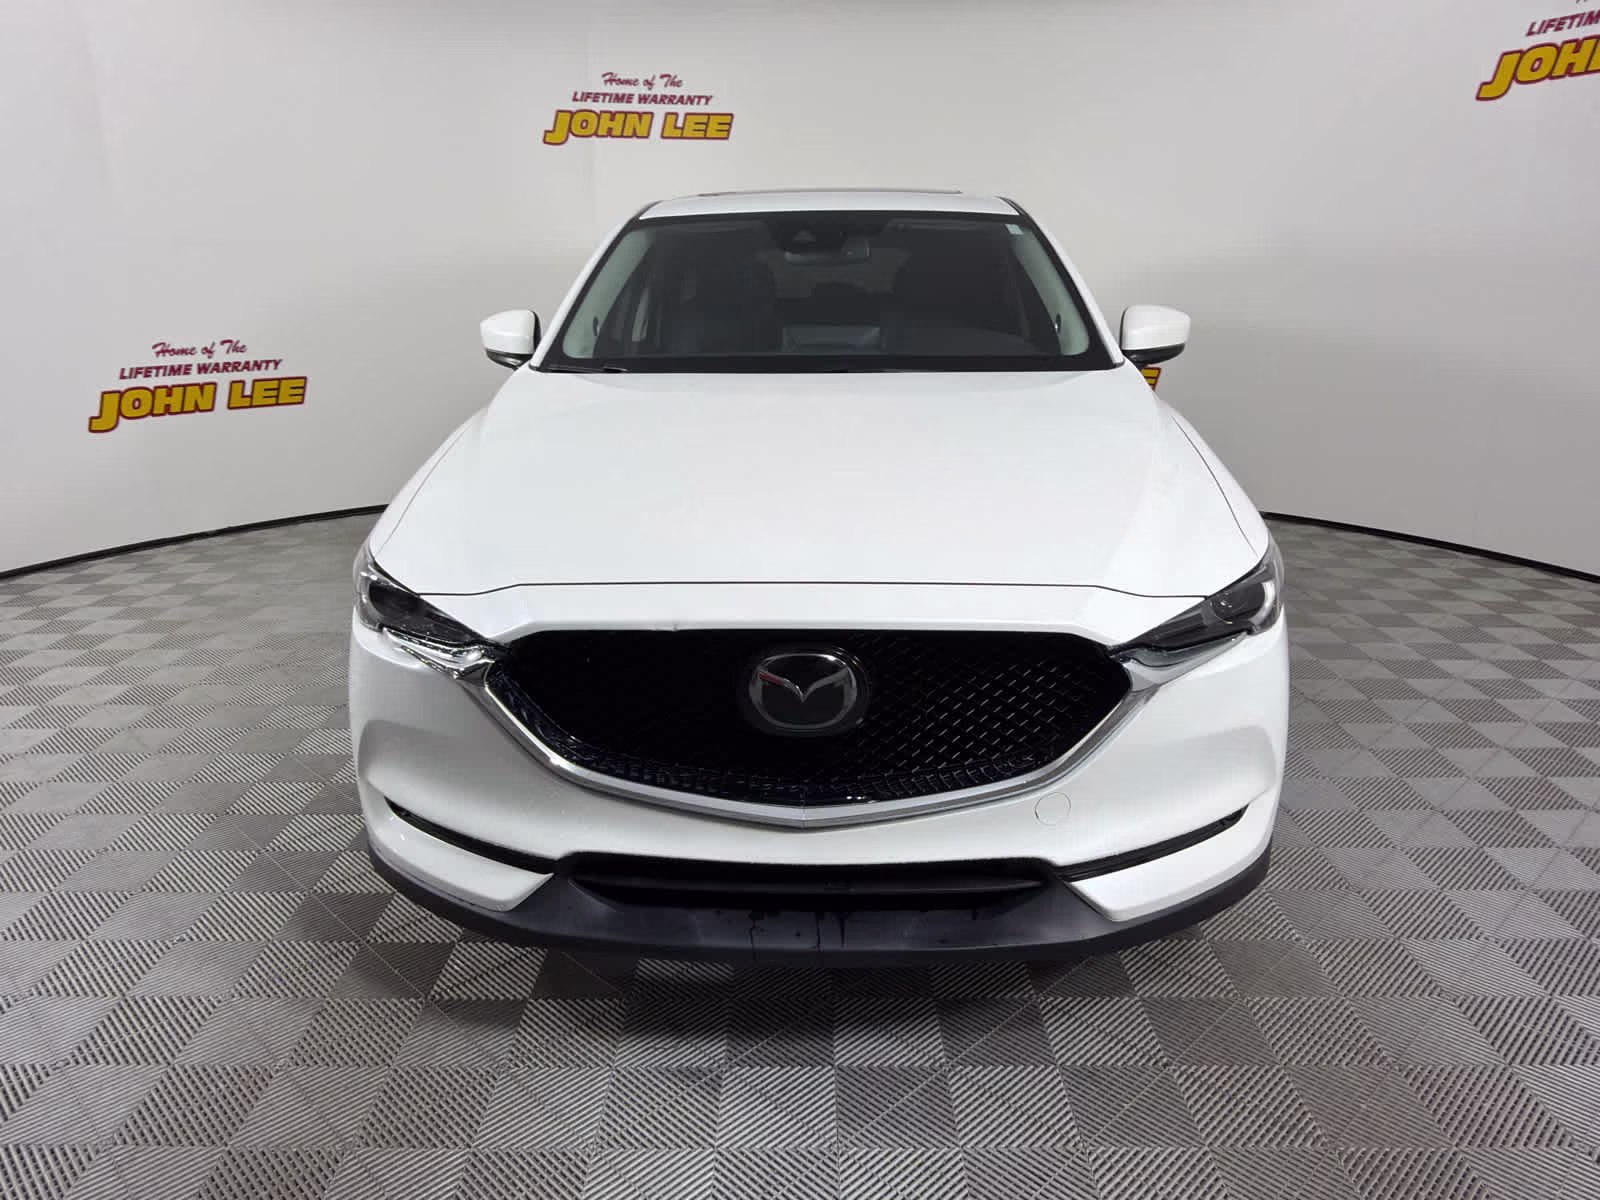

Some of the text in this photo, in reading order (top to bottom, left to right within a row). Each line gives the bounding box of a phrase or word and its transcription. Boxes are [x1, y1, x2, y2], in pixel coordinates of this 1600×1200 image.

[1476, 34, 1600, 101] JOH
[601, 72, 683, 90] Home of The
[572, 91, 713, 106] LIFETIME WARRANTY
[543, 109, 734, 145] JOHN LEE
[152, 339, 247, 359] Home of The
[119, 359, 283, 380] LIFETIME WARRANTY
[88, 376, 307, 433] JOHN LEE
